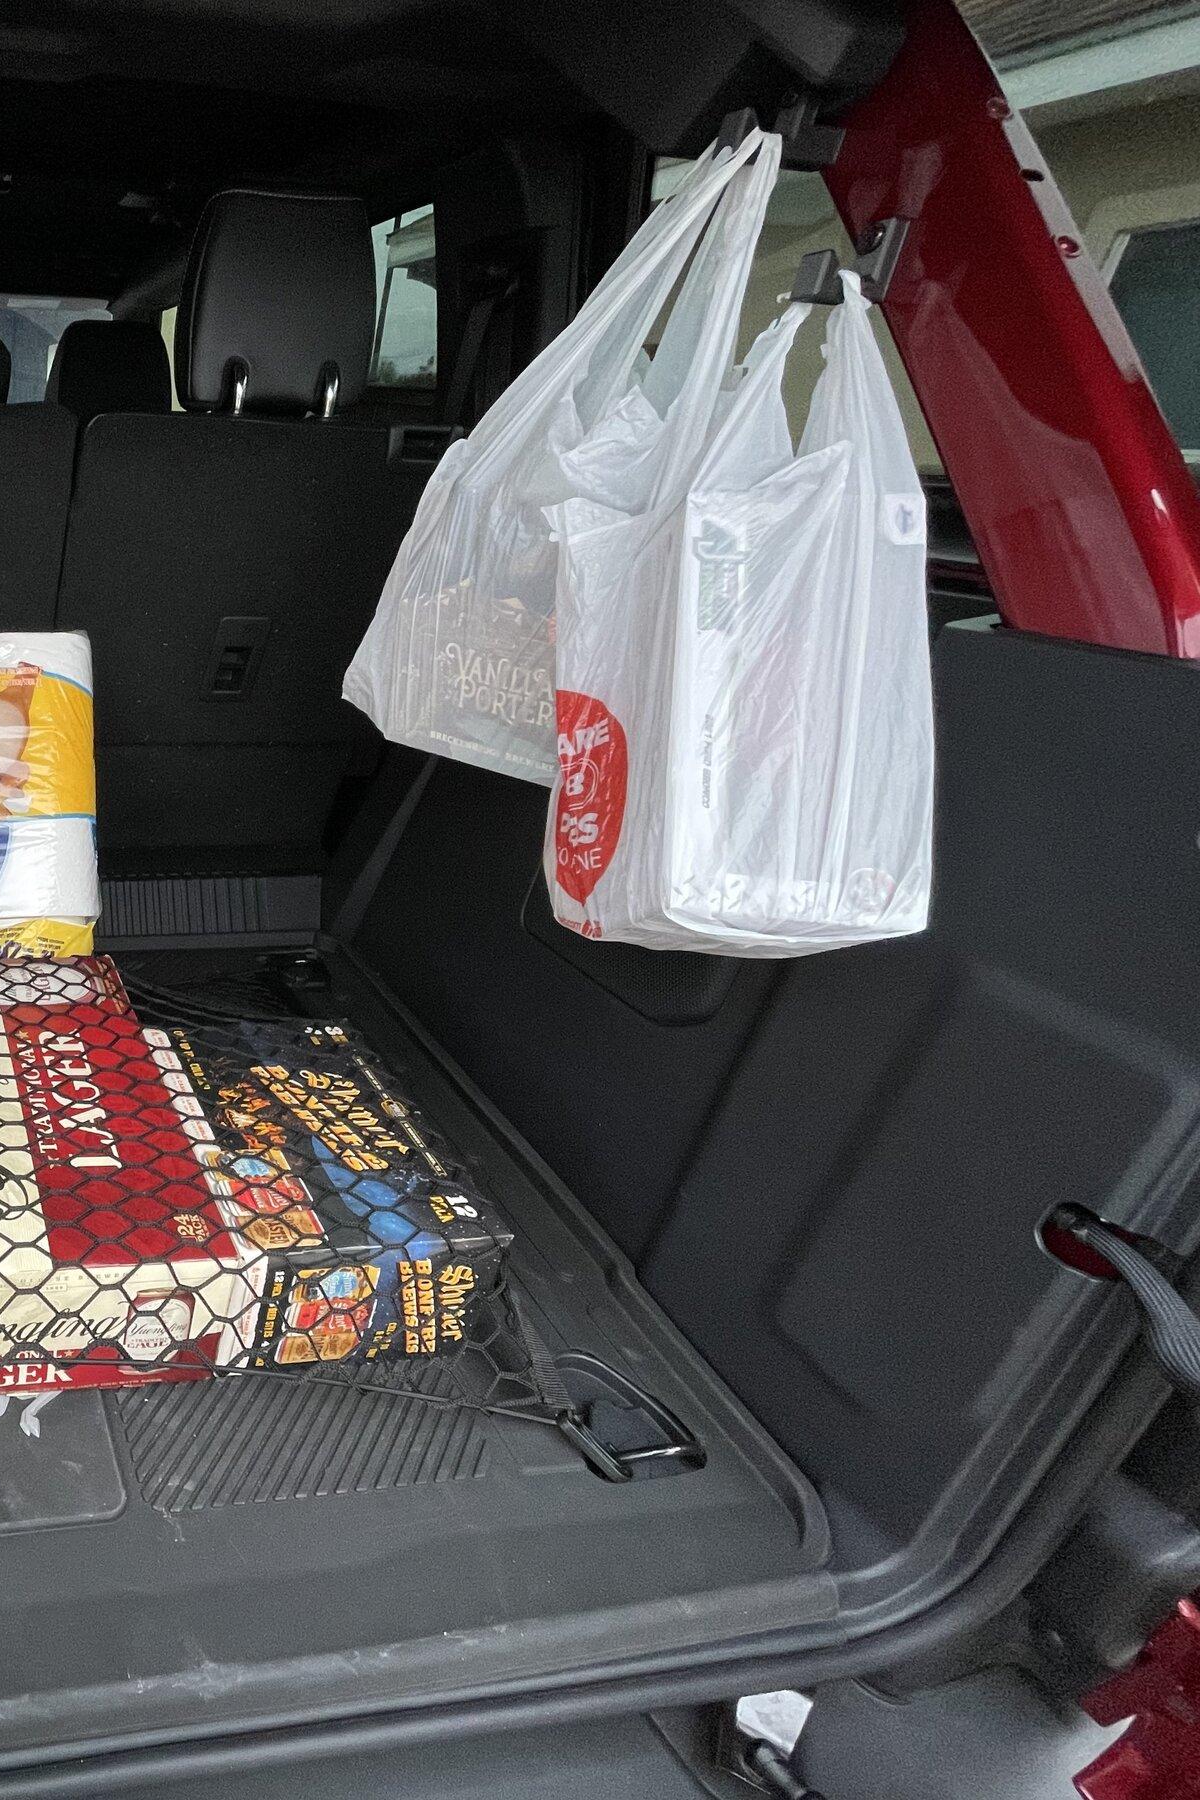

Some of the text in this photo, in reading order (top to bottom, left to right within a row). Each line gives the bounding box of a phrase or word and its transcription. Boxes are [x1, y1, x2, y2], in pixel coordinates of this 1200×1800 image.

[455, 677, 554, 726] PORTER
[39, 1028, 122, 1169] LAGER
[445, 1194, 478, 1218] 12
[174, 1213, 198, 1238] 24
[127, 1340, 170, 1349] LAGE
